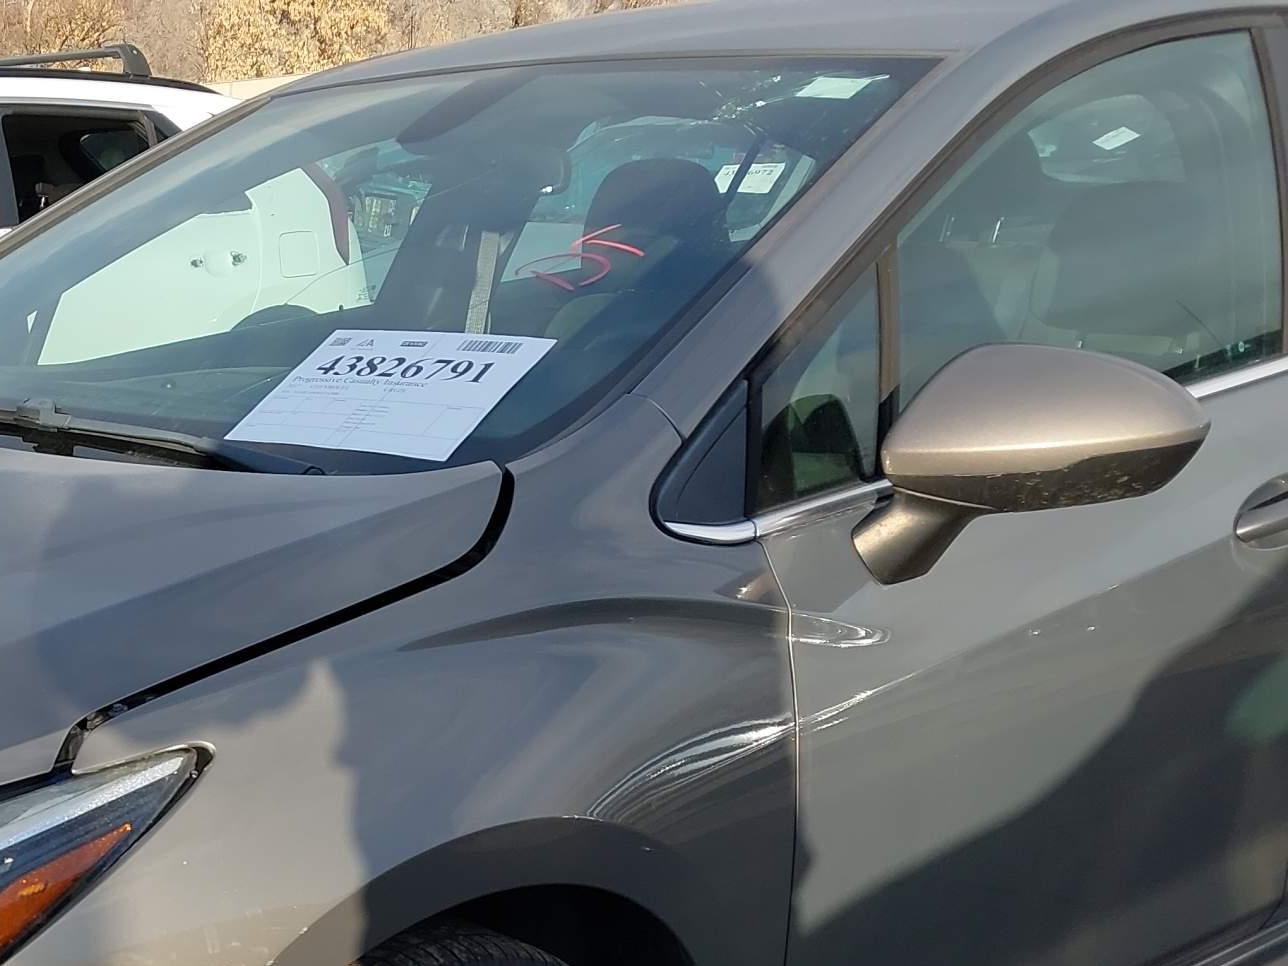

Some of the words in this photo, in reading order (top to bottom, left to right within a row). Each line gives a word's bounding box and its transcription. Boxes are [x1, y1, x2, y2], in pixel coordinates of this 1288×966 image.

[316, 354, 496, 384] 43826791
[344, 377, 381, 386] Casualty
[383, 379, 429, 388] Insurance
